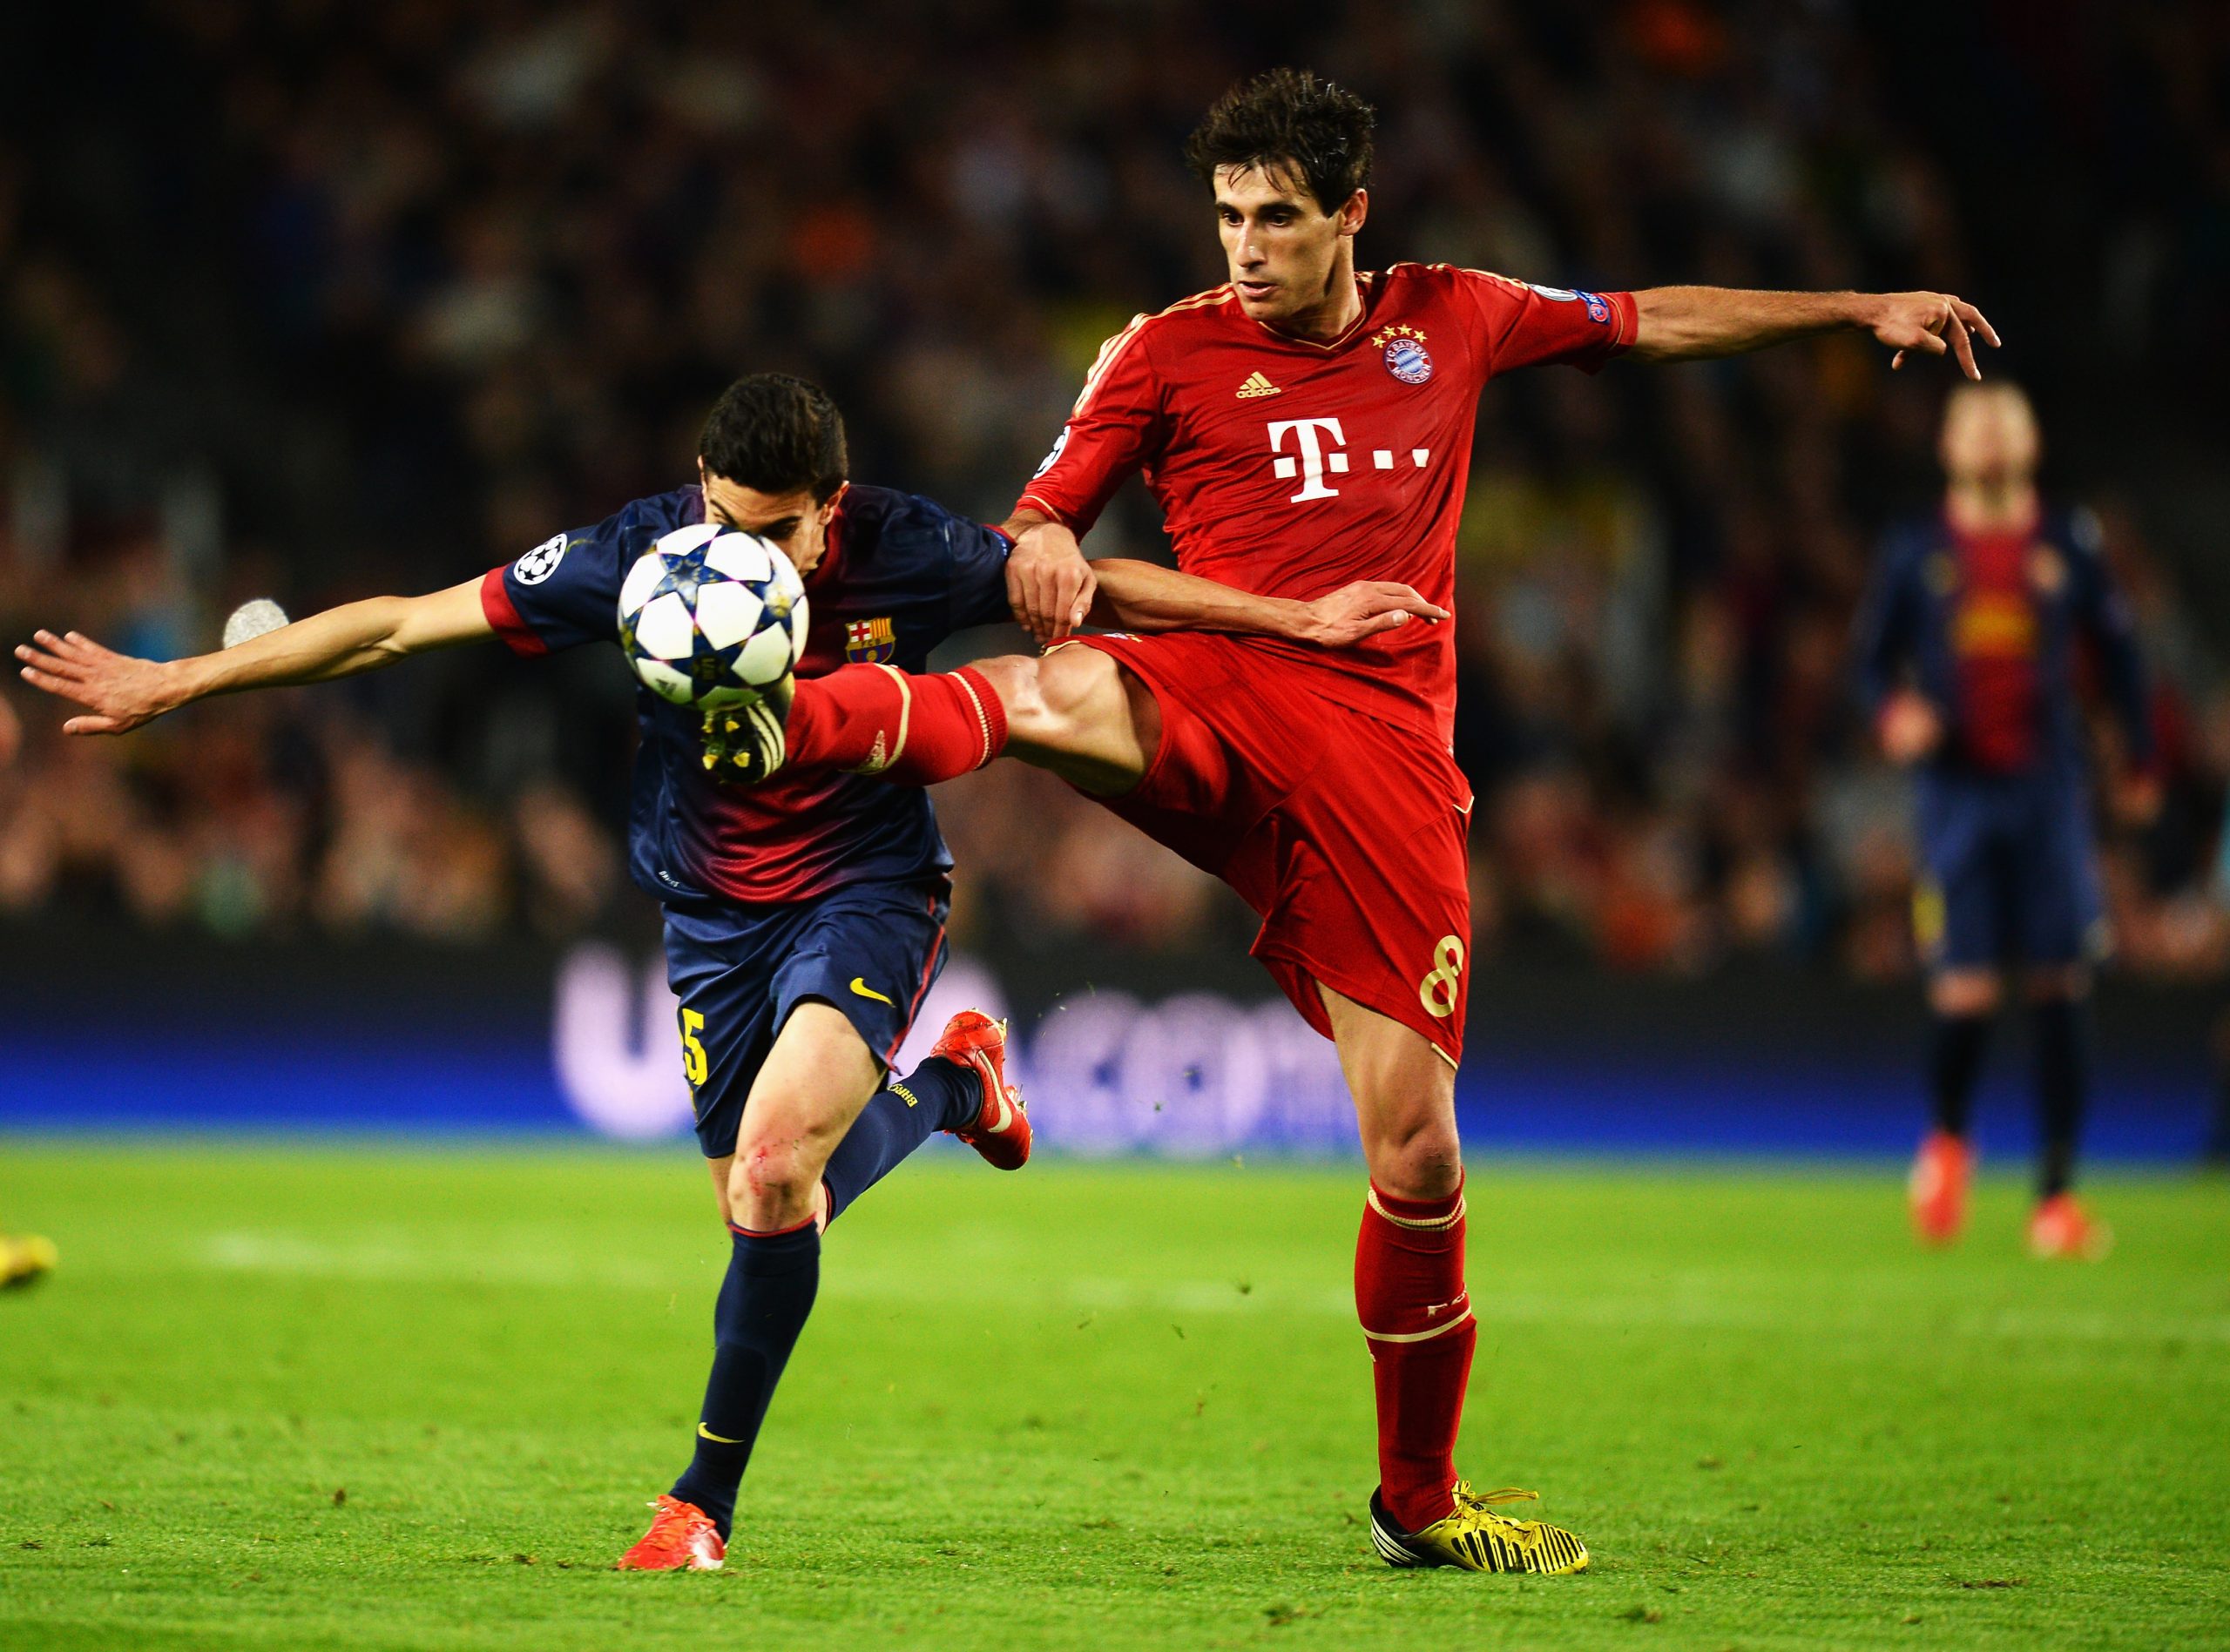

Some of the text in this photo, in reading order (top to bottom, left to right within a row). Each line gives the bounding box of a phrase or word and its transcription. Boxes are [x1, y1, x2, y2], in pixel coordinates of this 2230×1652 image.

[1392, 341, 1429, 360] BAYERN
[1235, 387, 1282, 399] adidas
[1419, 934, 1464, 1018] 8
